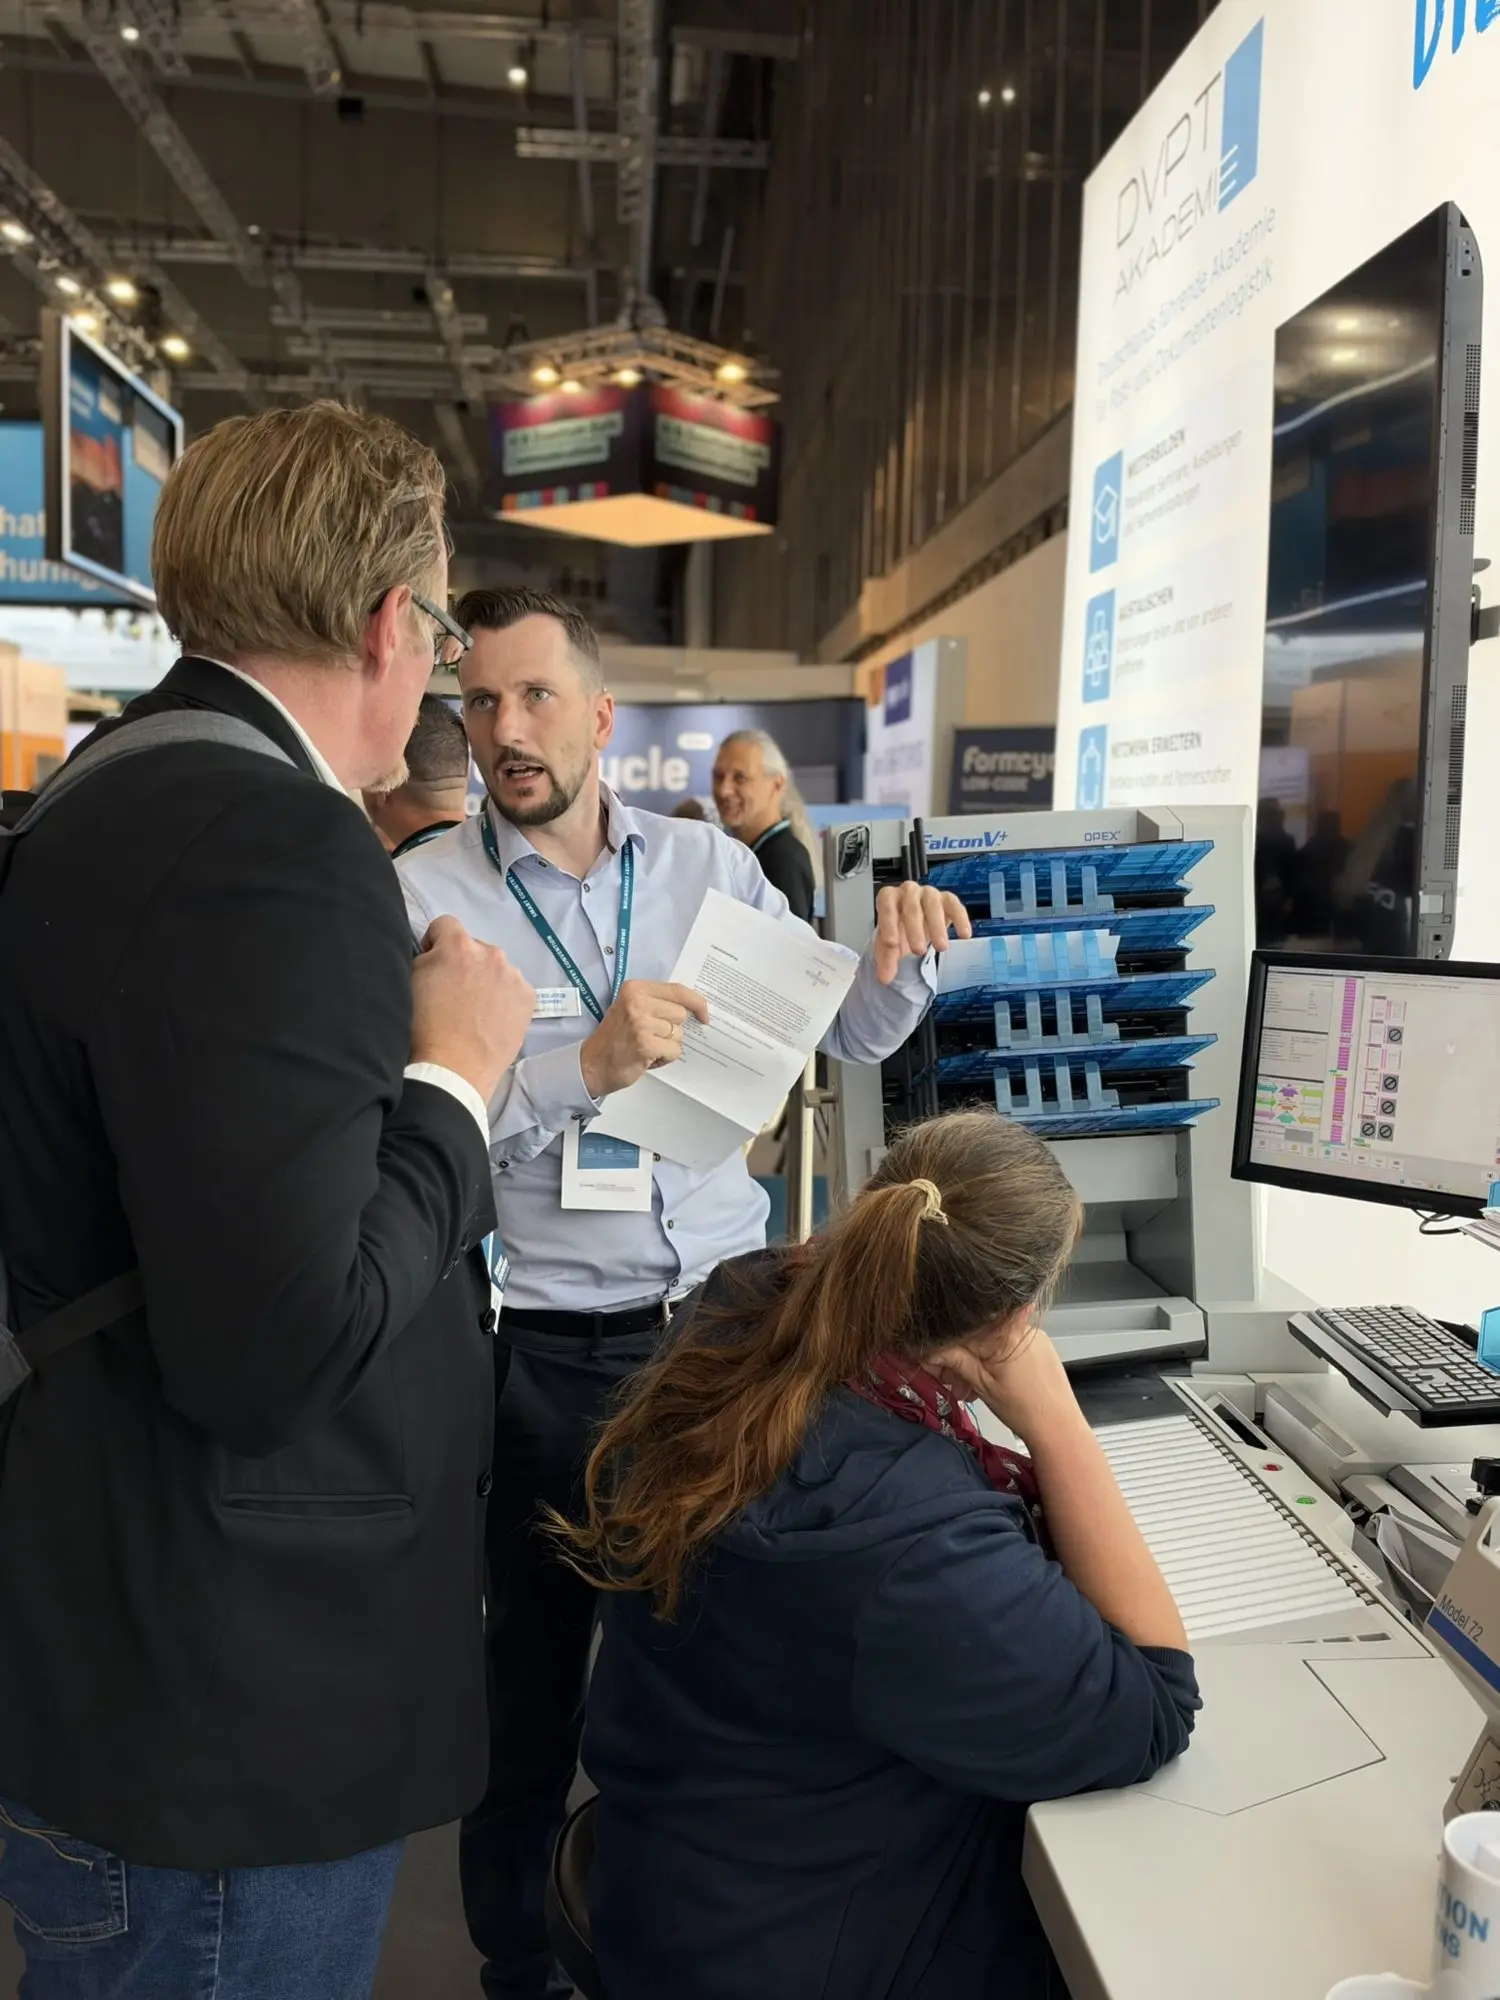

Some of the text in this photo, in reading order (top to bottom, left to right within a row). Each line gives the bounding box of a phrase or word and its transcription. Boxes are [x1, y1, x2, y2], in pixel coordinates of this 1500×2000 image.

[1116, 70, 1221, 249] DVPT
[1113, 143, 1239, 306] AKADEMIE
[1210, 206, 1277, 285] Akademie
[1439, 1594, 1484, 1643] Model 72
